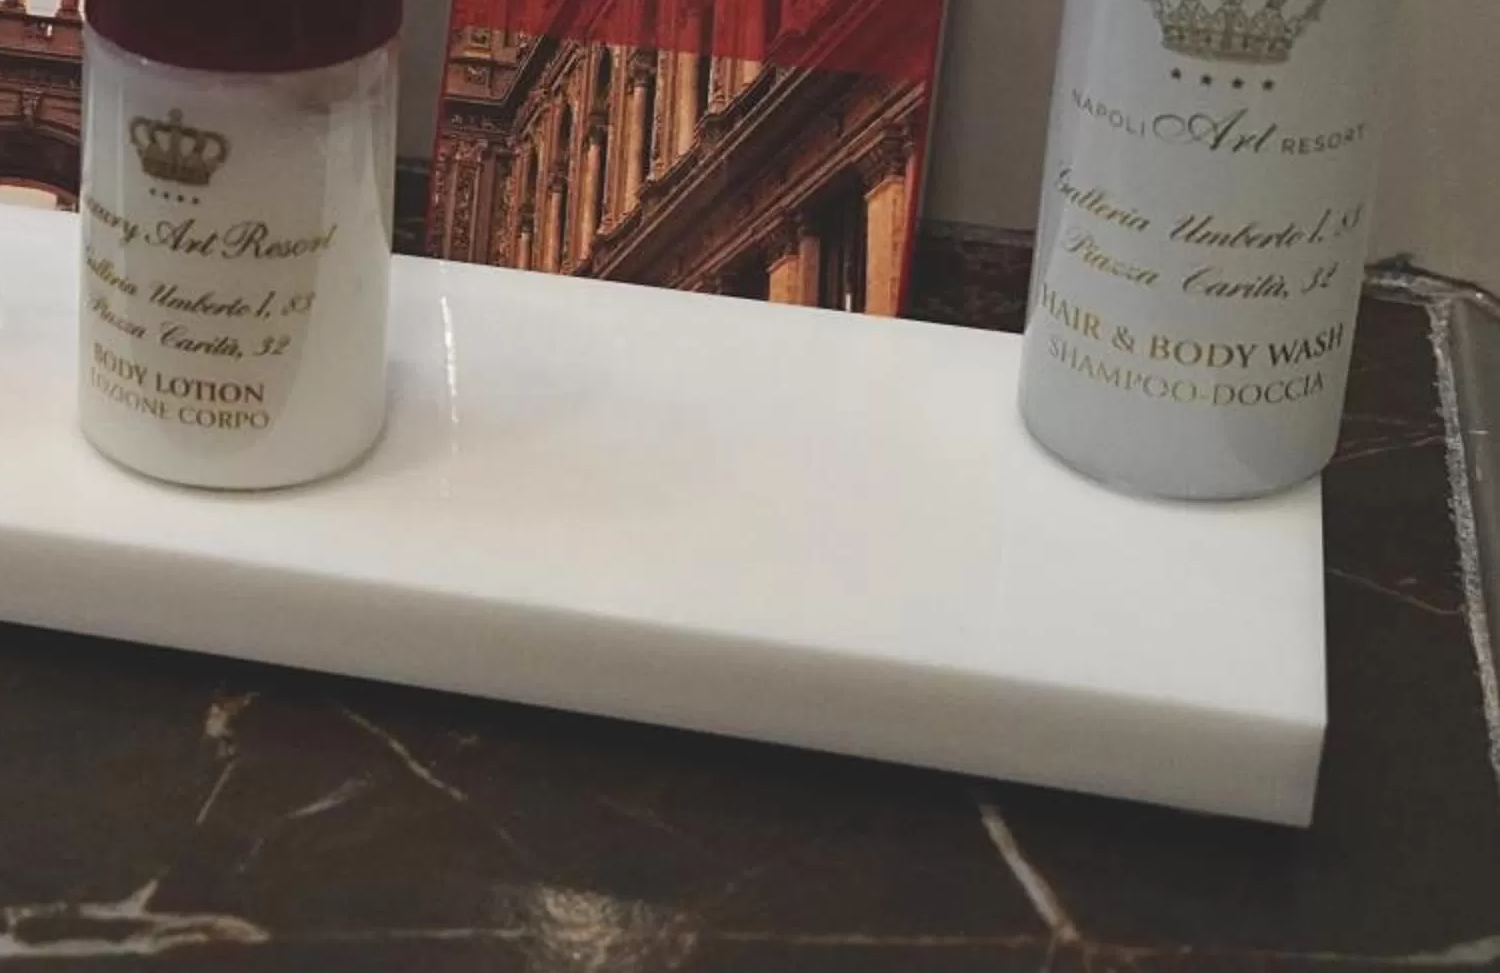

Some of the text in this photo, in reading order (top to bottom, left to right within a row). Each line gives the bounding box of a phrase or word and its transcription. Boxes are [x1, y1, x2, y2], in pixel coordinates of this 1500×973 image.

[1072, 88, 1364, 156] NAPOLI Art RESORT
[1055, 161, 1151, 232] Galleria
[1169, 214, 1305, 248] Umberto
[144, 218, 217, 257] Art
[220, 221, 338, 259] Resort
[1061, 230, 1160, 286] Piazza
[150, 281, 252, 317] Umberto
[1040, 282, 1344, 369] HAIR & BODY WASH
[94, 342, 265, 404] BODY LOTION
[252, 335, 292, 356] 32
[1049, 336, 1325, 407] SHAMPOO-DOCCIA
[179, 406, 269, 430] CORPO
